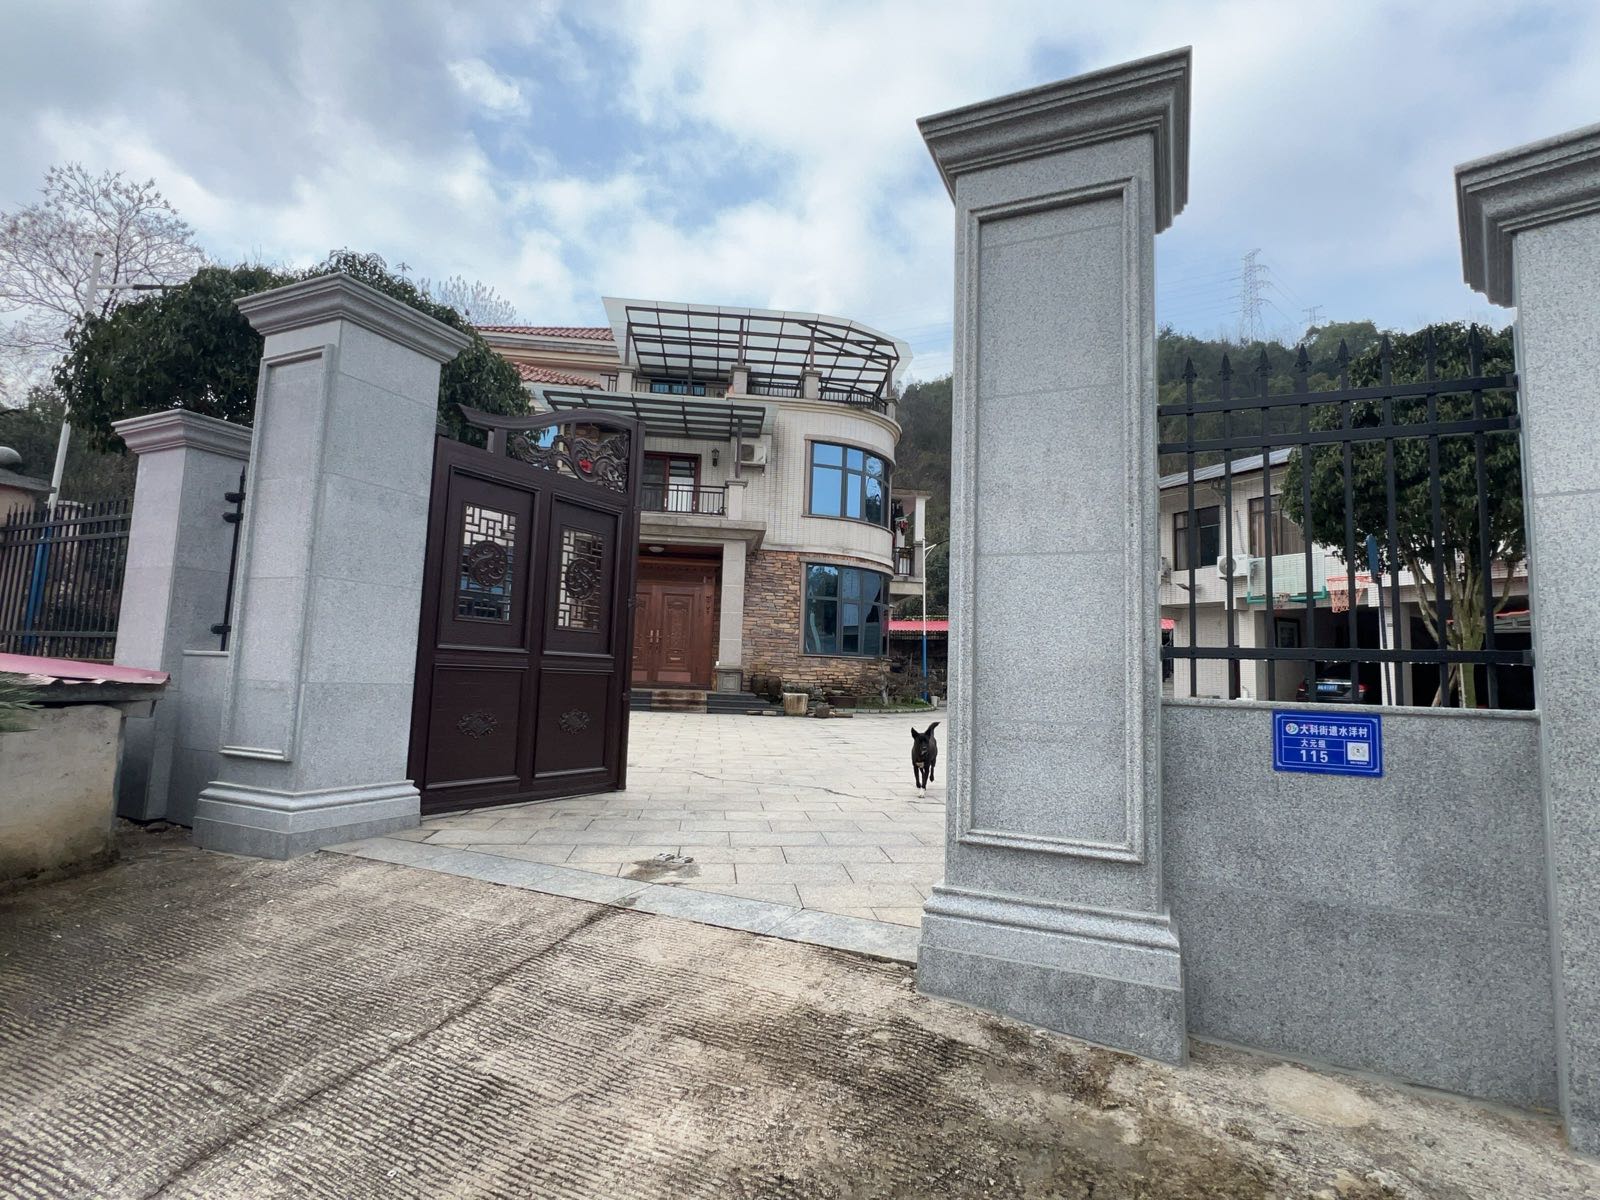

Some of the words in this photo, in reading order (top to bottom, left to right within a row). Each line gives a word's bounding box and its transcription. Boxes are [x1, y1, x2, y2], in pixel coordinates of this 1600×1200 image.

[1300, 724, 1367, 738] 大科街道水洋村
[1300, 749, 1328, 763] 115
